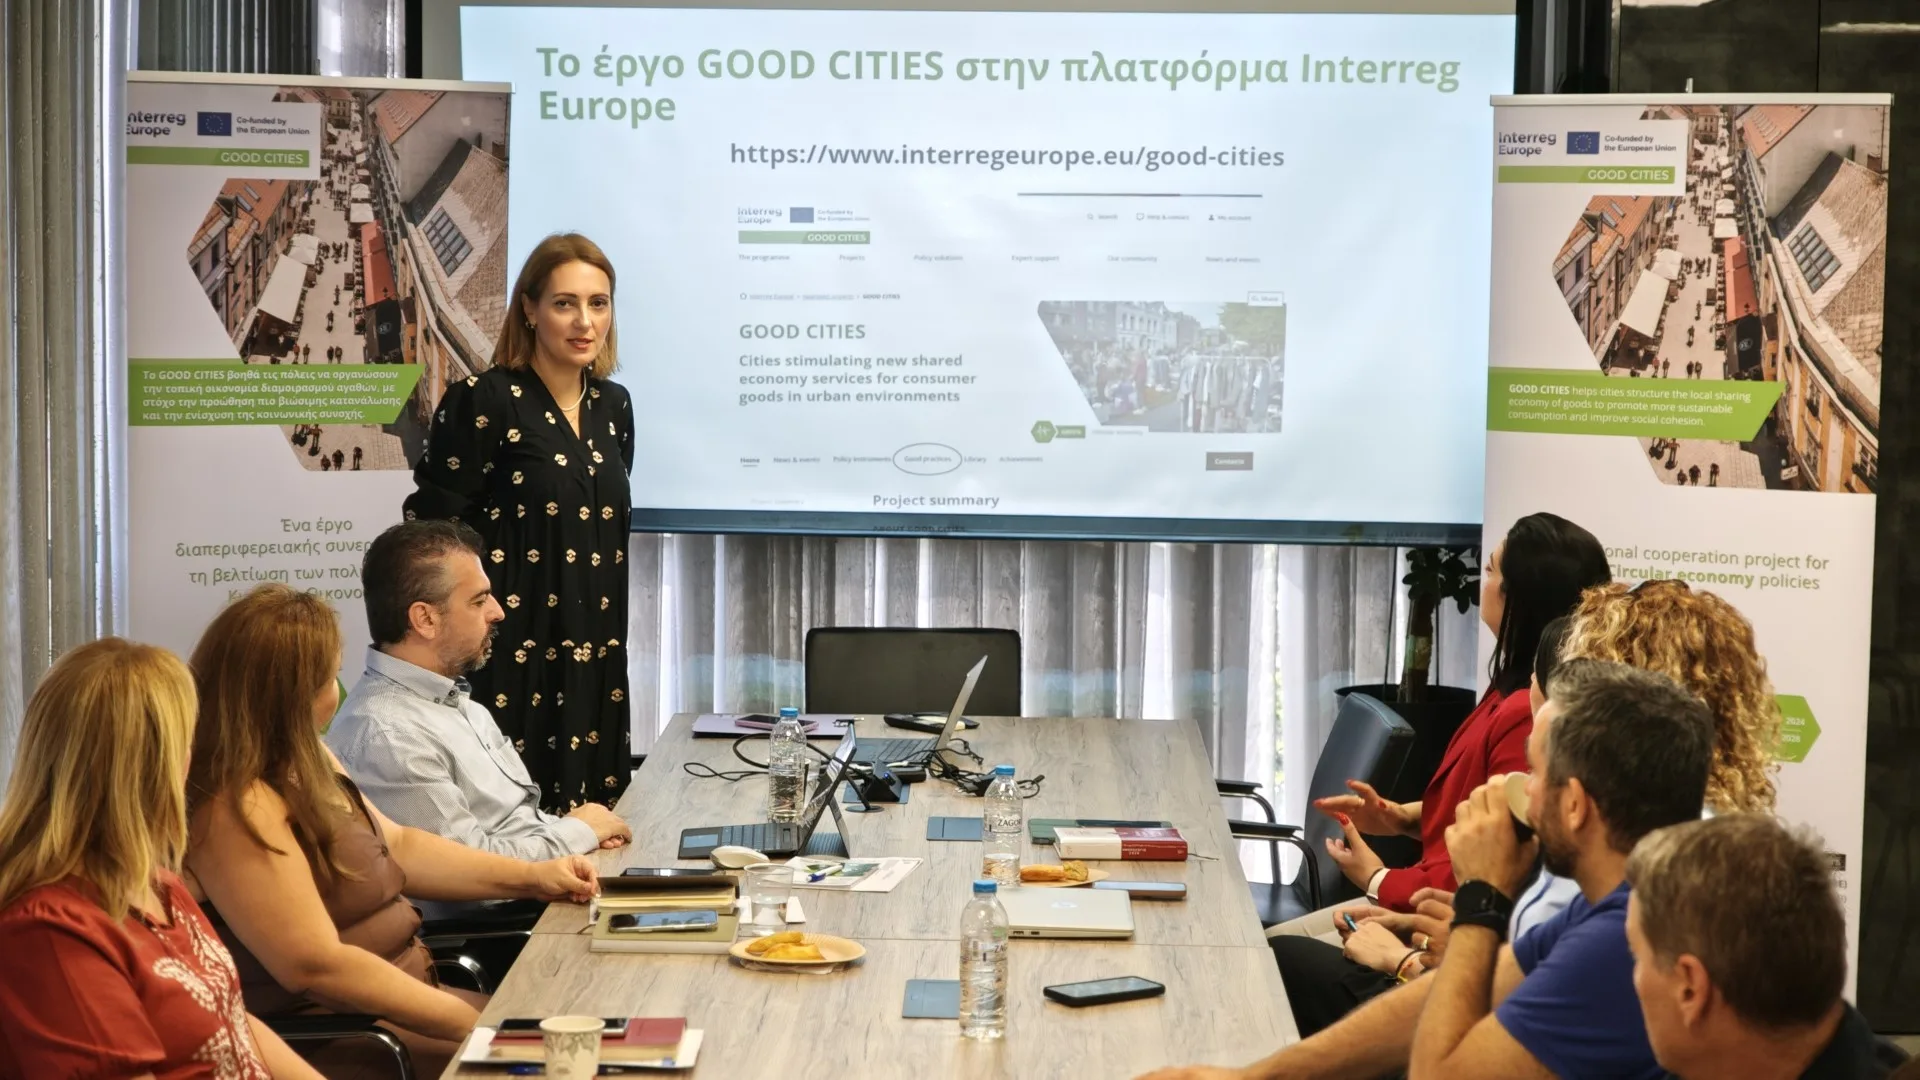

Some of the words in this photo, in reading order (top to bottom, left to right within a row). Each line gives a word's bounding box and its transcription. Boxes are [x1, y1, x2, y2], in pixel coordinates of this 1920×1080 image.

[536, 47, 581, 78] Το
[593, 45, 685, 87] έργο
[697, 48, 815, 80] GOOD
[828, 50, 944, 81] CITIES
[956, 56, 1050, 90] στην
[1061, 49, 1289, 92] πλατφόρμα
[1301, 54, 1461, 93] Interreg
[540, 90, 677, 129] Europe
[127, 111, 186, 126] nterreg
[236, 116, 275, 125] Co-funded
[277, 117, 287, 126] by
[236, 126, 249, 134] the
[250, 127, 286, 136] European
[1498, 132, 1557, 145] Interreg
[1645, 136, 1654, 144] by
[220, 152, 261, 163] GOOD
[263, 153, 304, 164] CITIES
[730, 143, 1285, 172] https://www.interregeurope.eu/good-cities
[1498, 145, 1542, 157] Europe
[1588, 169, 1627, 180] GOOD
[1630, 170, 1669, 180] CITIES
[737, 207, 782, 217] Interreg
[807, 233, 836, 242] GOOD
[837, 233, 867, 242] CITIES
[739, 324, 800, 339] GOOD
[806, 324, 866, 339] CITIES
[739, 354, 781, 366] Cities
[785, 354, 872, 369] stimulating
[876, 357, 907, 366] new
[911, 354, 963, 366] shared
[159, 370, 191, 380] GOOD
[194, 370, 225, 380] CITIES
[227, 369, 260, 381] βοηθά
[263, 371, 278, 381] τις
[281, 370, 316, 381] πόλεις
[333, 370, 398, 382] οργανώσουν
[739, 374, 807, 387] economy
[812, 372, 872, 384] services
[877, 372, 899, 384] for
[902, 374, 977, 384] consumer
[143, 385, 162, 395] την
[165, 384, 202, 395] τοπική
[205, 383, 258, 395] οικονομία
[261, 383, 334, 394] διαμοιρασμού
[382, 385, 395, 394] με
[1509, 384, 1538, 394] GOOD
[1540, 385, 1570, 395] CITIES
[1572, 385, 1598, 398] helps
[1600, 387, 1624, 397] cities
[1627, 388, 1670, 399] structure
[1672, 388, 1688, 399] the
[1690, 390, 1713, 400] local
[1715, 390, 1752, 403] sharing
[143, 398, 175, 408] στόχο
[178, 399, 197, 408] την
[200, 397, 254, 408] προώθηση
[278, 396, 327, 407] βιώσιμης
[329, 396, 401, 407] κατανάλωσης
[739, 390, 784, 406] goods
[788, 390, 802, 402] in
[806, 390, 850, 402] urban
[856, 390, 960, 402] environments
[1508, 398, 1549, 409] economy
[1552, 397, 1562, 408] of
[1563, 398, 1592, 411] goods
[1595, 400, 1605, 409] to
[1607, 401, 1648, 413] promote
[1650, 403, 1676, 412] more
[1678, 402, 1733, 414] sustainable
[143, 412, 161, 420] και
[164, 412, 183, 421] την
[185, 411, 233, 422] ενίσχυση
[237, 412, 255, 421] της
[257, 410, 317, 421] κοινωνικής
[1508, 410, 1567, 422] consumption
[1569, 411, 1588, 421] and
[1590, 412, 1630, 425] improve
[1632, 413, 1658, 424] social
[1660, 414, 1706, 426] cohesion.
[873, 494, 925, 509] Project
[929, 496, 999, 509] summary
[281, 518, 311, 533] Ένα
[316, 517, 353, 535] έργο
[175, 538, 321, 559] διαπεριφερειακής
[325, 541, 371, 554] συνερ
[1604, 544, 1638, 559] onal
[1643, 549, 1739, 566] cooperation
[1744, 552, 1800, 571] project
[1806, 554, 1829, 570] for
[189, 573, 207, 586] τη
[213, 566, 288, 586] βελτίωση
[294, 567, 323, 580] των
[328, 563, 362, 579] πολ
[1677, 570, 1754, 588] economy
[1760, 572, 1820, 590] policies
[306, 587, 364, 600] Οικονο
